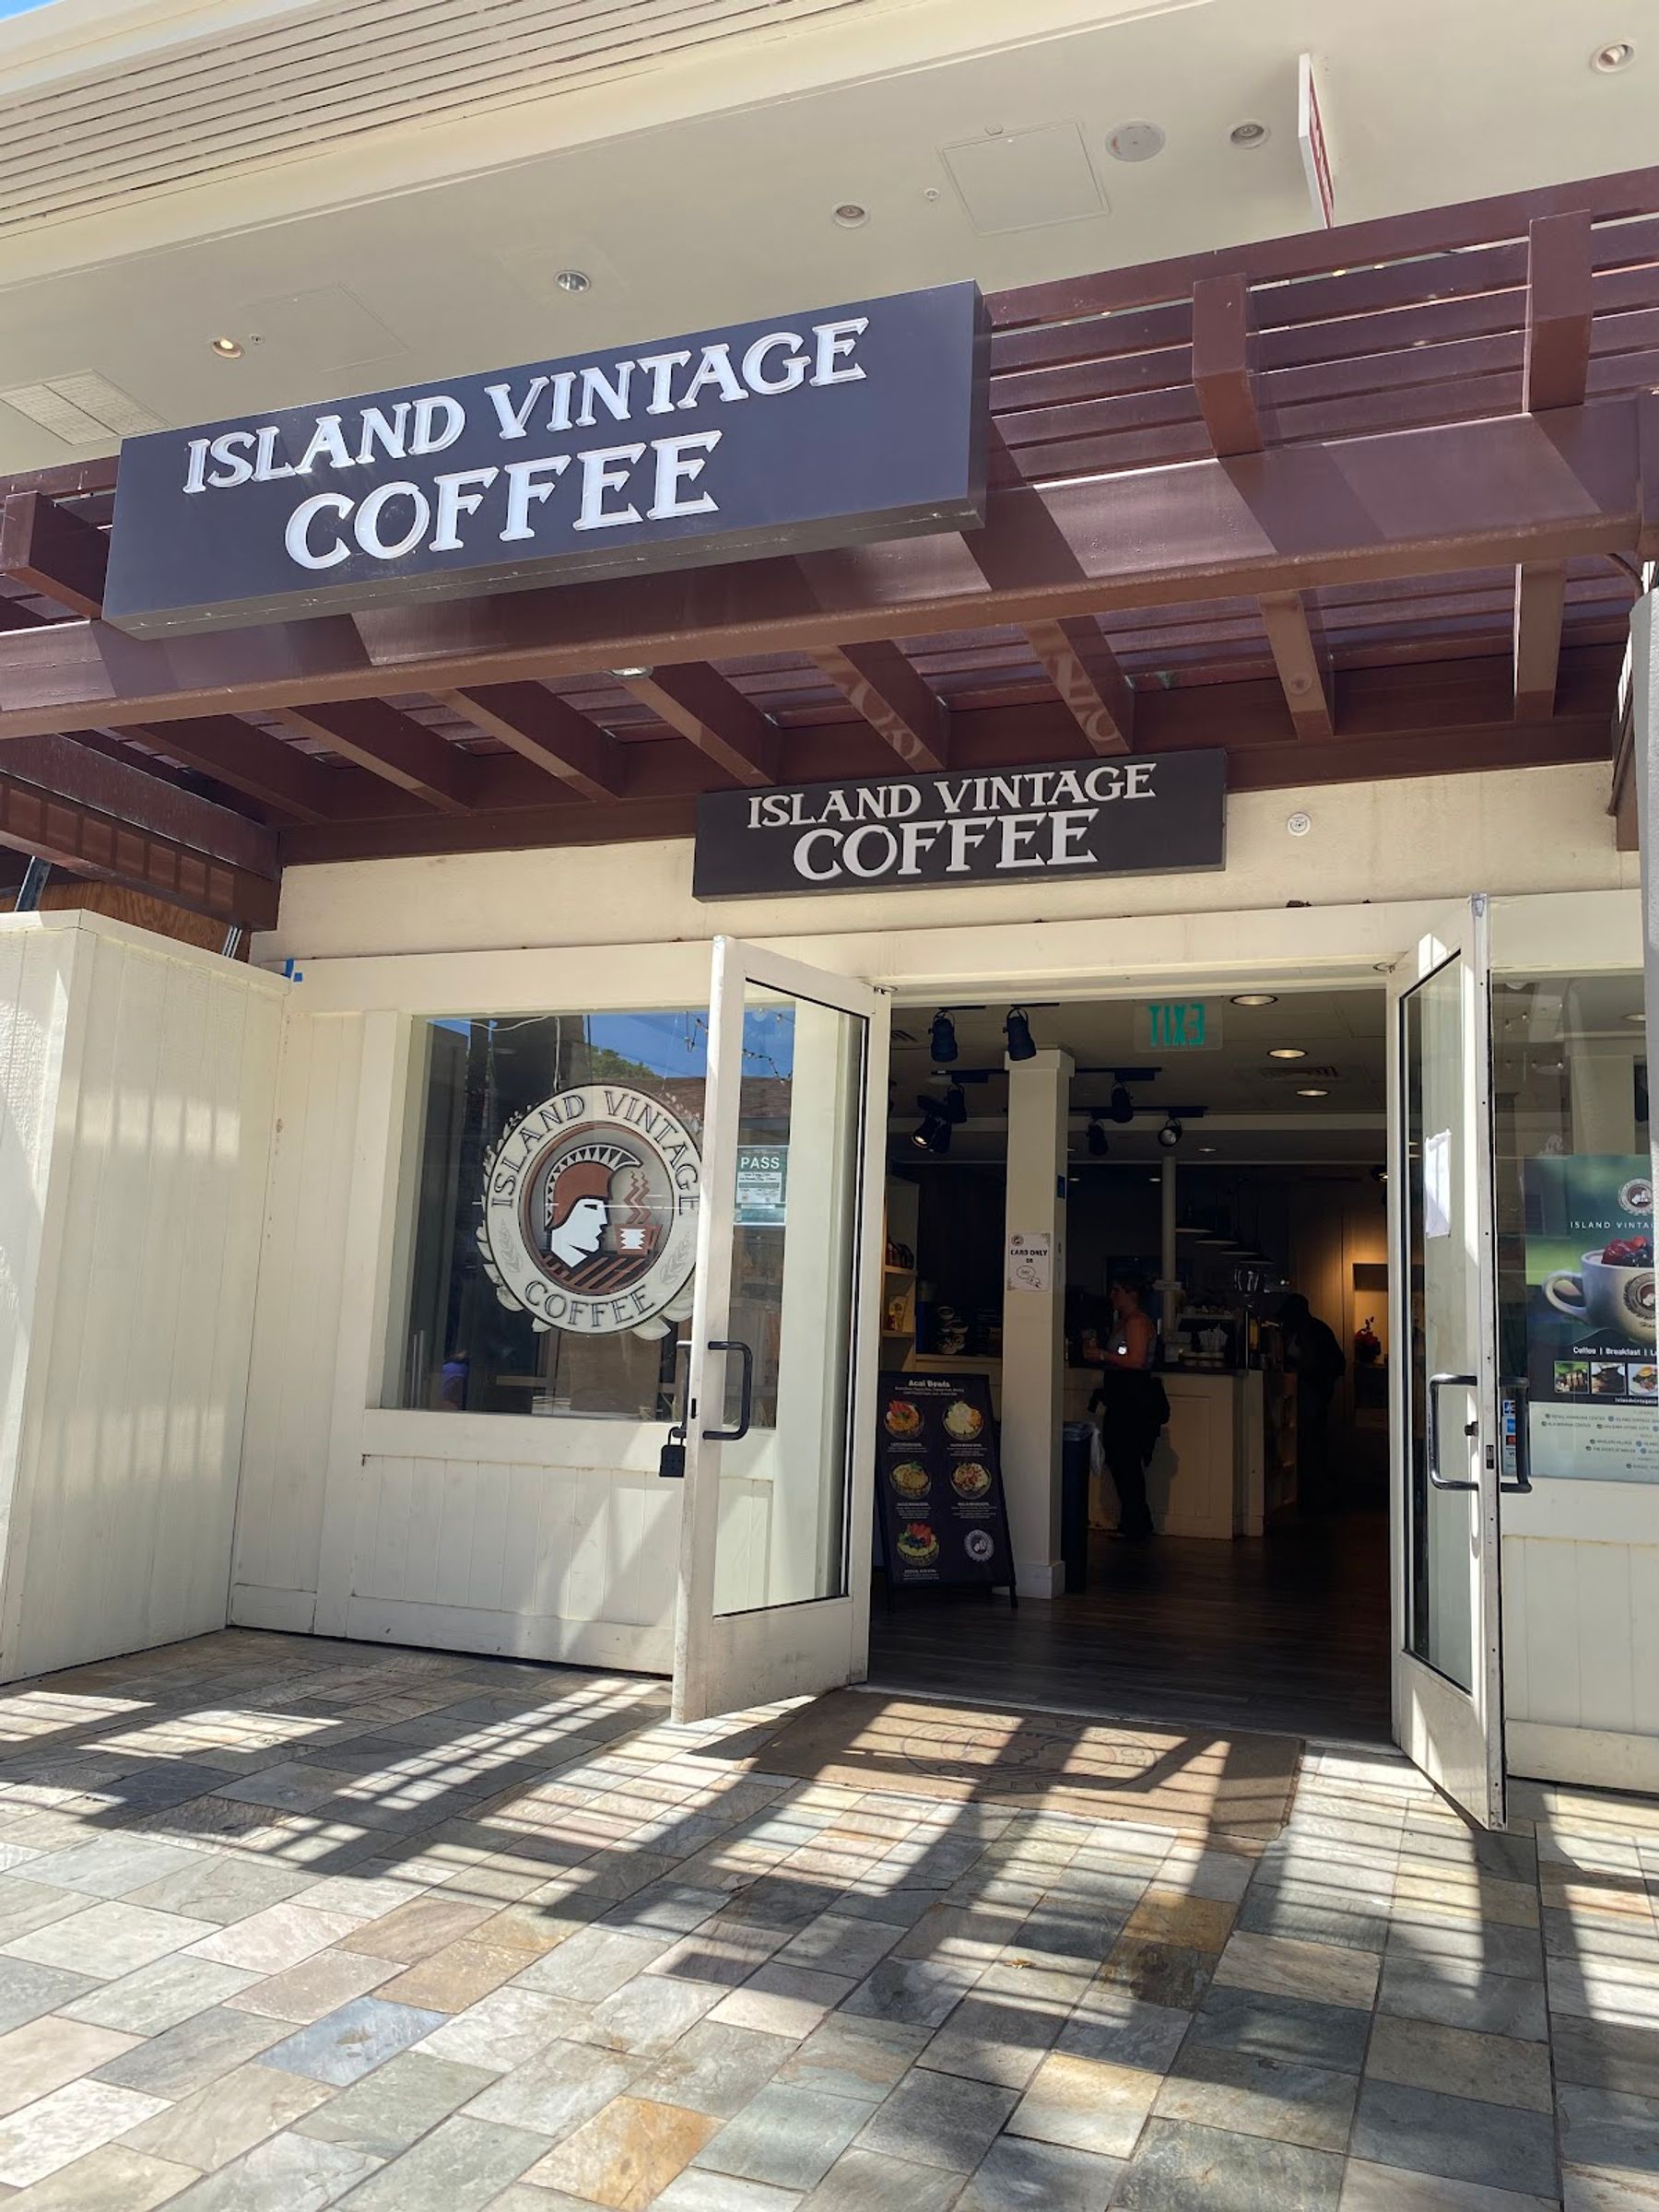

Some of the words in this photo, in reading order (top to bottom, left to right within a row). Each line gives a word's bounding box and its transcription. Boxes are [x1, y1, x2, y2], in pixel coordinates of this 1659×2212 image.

[183, 395, 465, 494] ISLAND
[485, 317, 868, 439] VINTAGE
[285, 429, 723, 570] COFFEE
[747, 784, 921, 828] ISLAND
[934, 763, 1157, 813] VINTAGE
[794, 808, 1099, 881] COFFEE
[492, 1095, 585, 1208] ISLAND
[604, 1090, 700, 1216] VINTAGE
[740, 1157, 781, 1170] PASS
[1570, 1221, 1611, 1230] ISLAND
[1616, 1221, 1653, 1230] VINTA
[525, 1280, 655, 1327] COFFEE
[1572, 1347, 1596, 1355] Coffee
[1606, 1347, 1641, 1357] Breakfast
